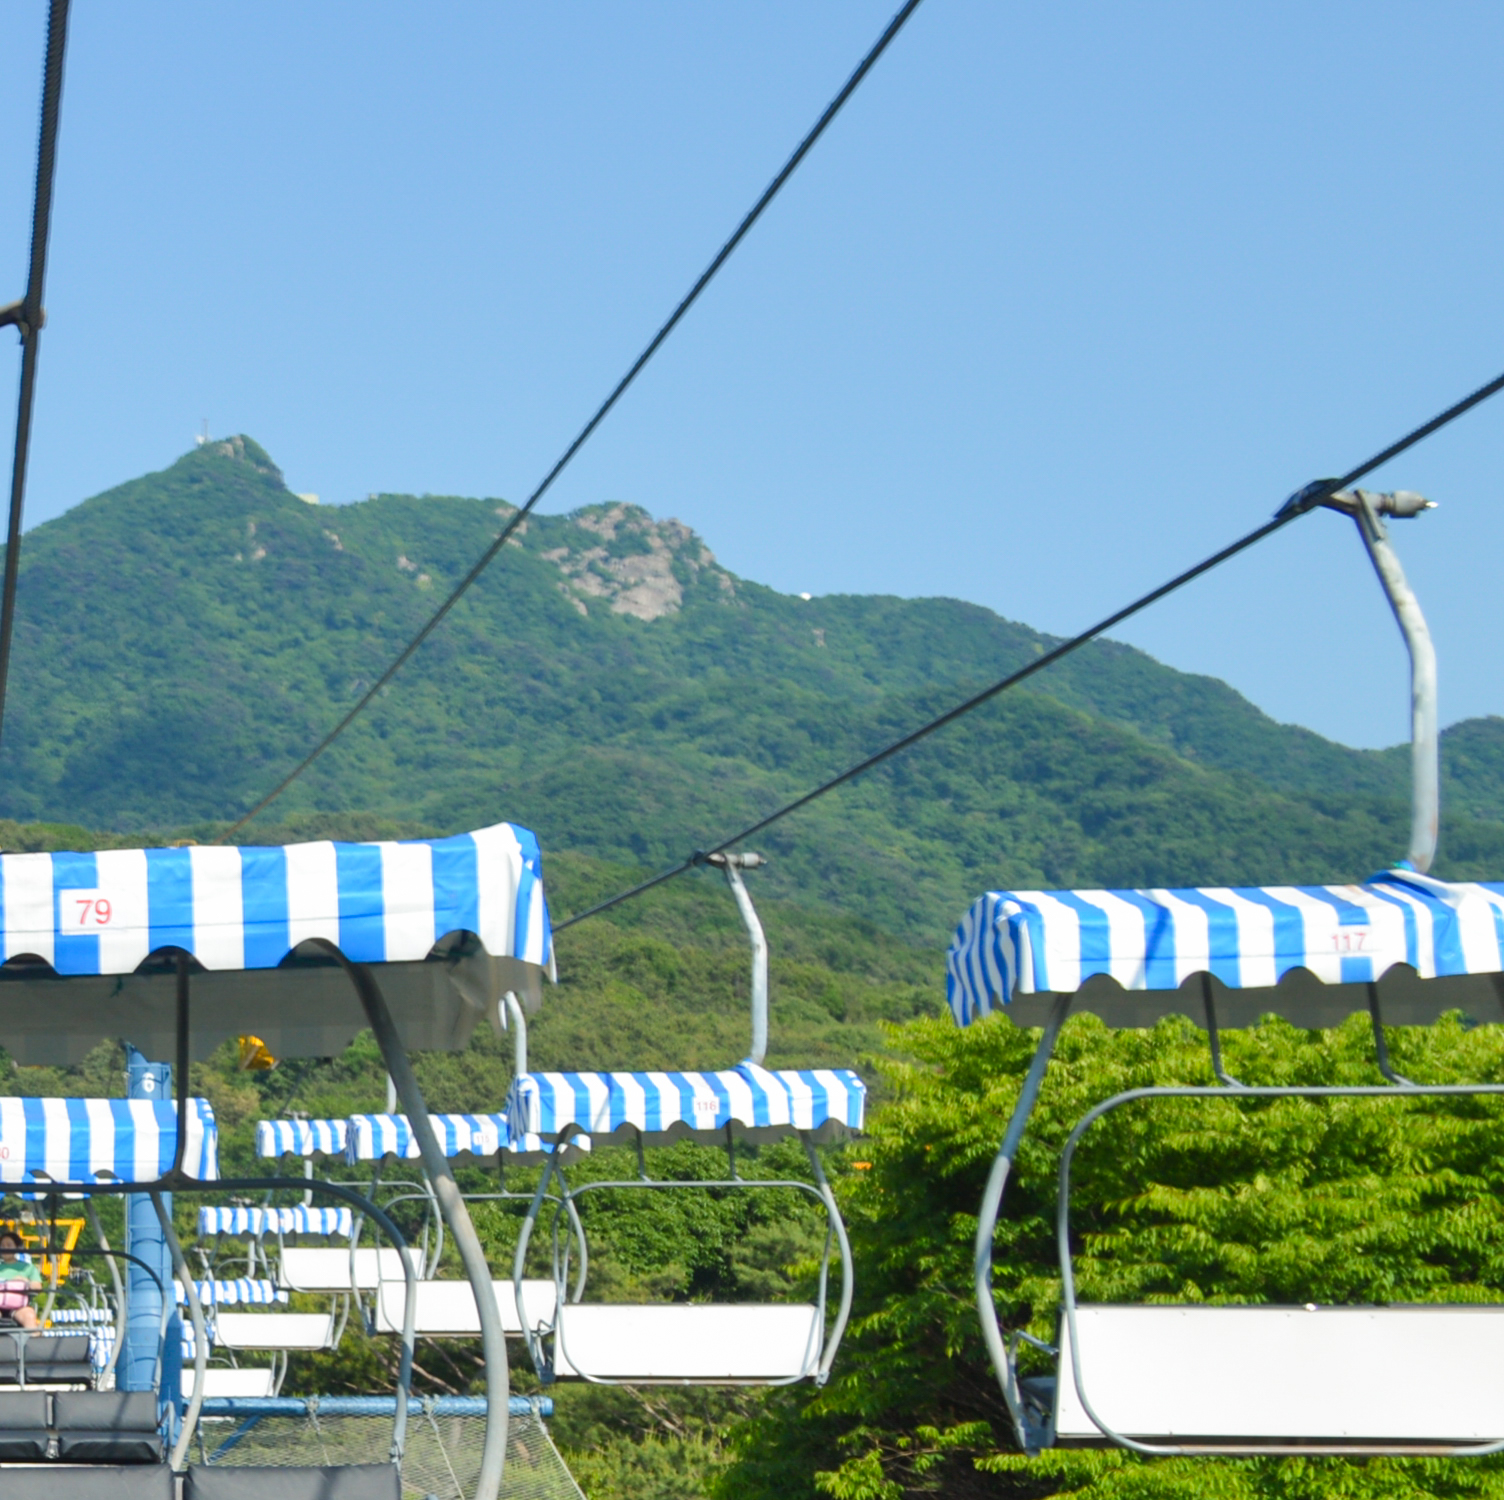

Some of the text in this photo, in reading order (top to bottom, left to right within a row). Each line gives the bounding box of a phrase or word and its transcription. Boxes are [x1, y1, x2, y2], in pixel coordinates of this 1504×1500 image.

[75, 898, 113, 925] 79
[1330, 931, 1368, 951] 117
[696, 1101, 717, 1111] 116
